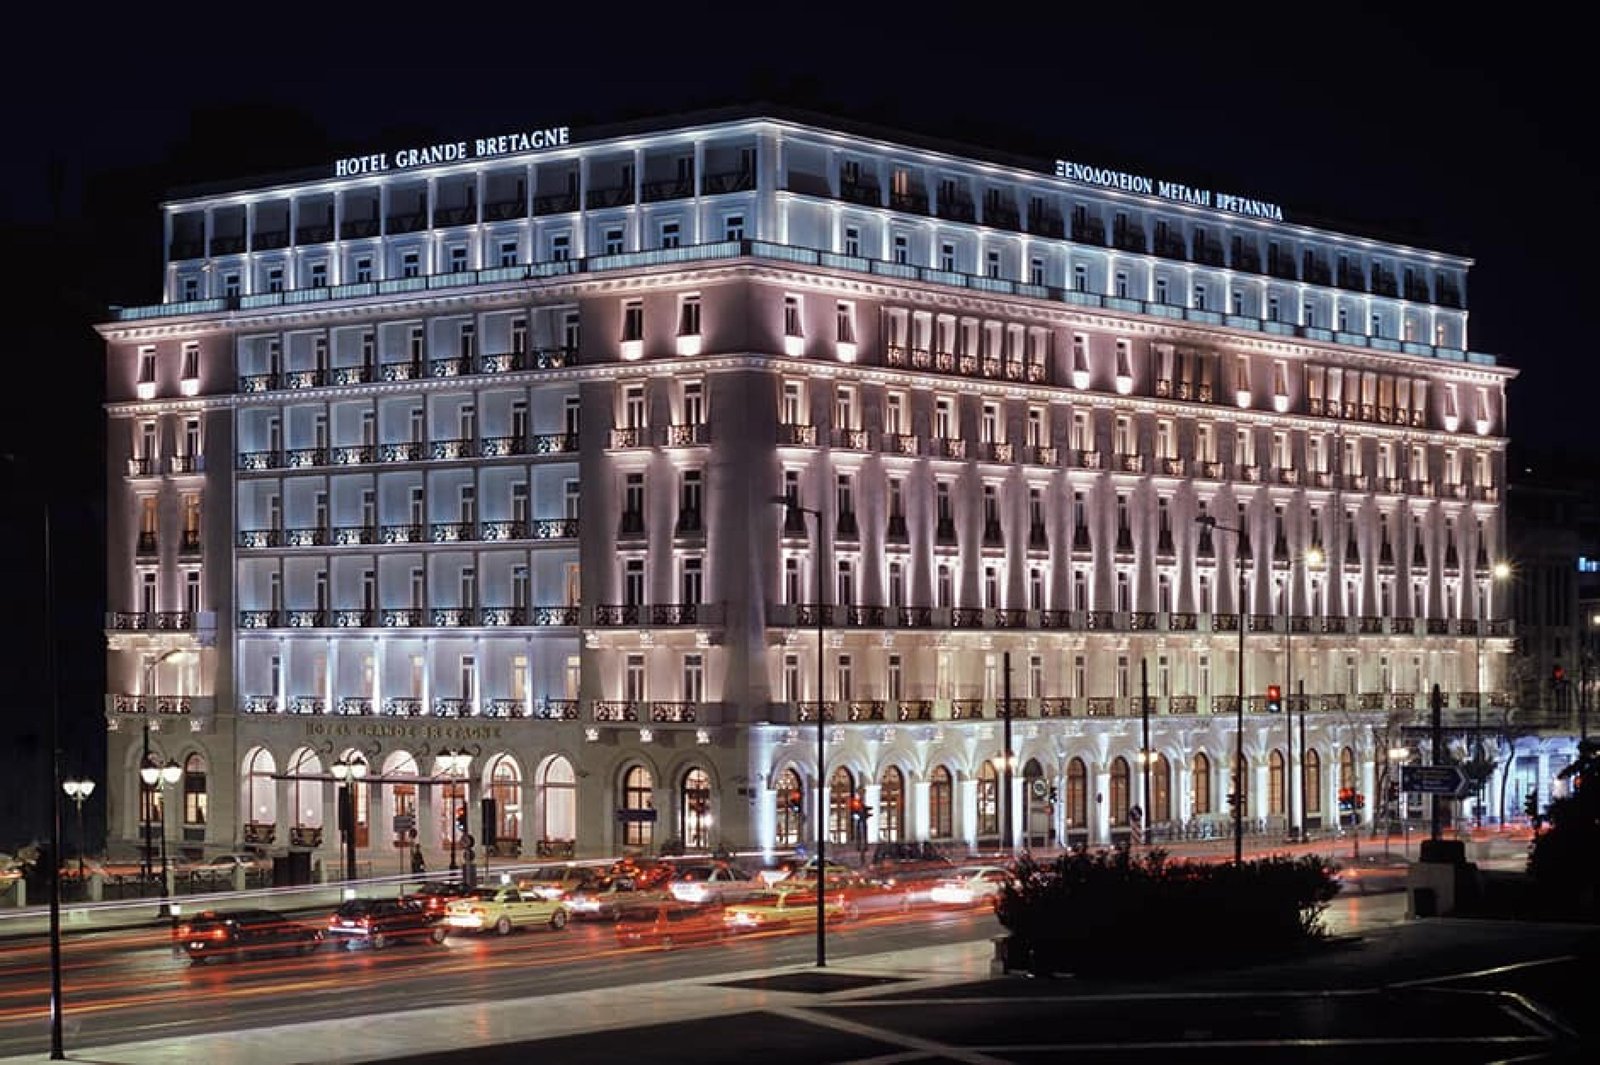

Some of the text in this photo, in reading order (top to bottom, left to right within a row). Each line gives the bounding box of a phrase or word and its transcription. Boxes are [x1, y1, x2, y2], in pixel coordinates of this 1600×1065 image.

[336, 126, 570, 177] HOTEL GRANDE BRETAGNE
[1055, 159, 1153, 194] ΞΕΝΟΔΟΧΕΙΟΝ
[305, 721, 349, 736] HOTEL
